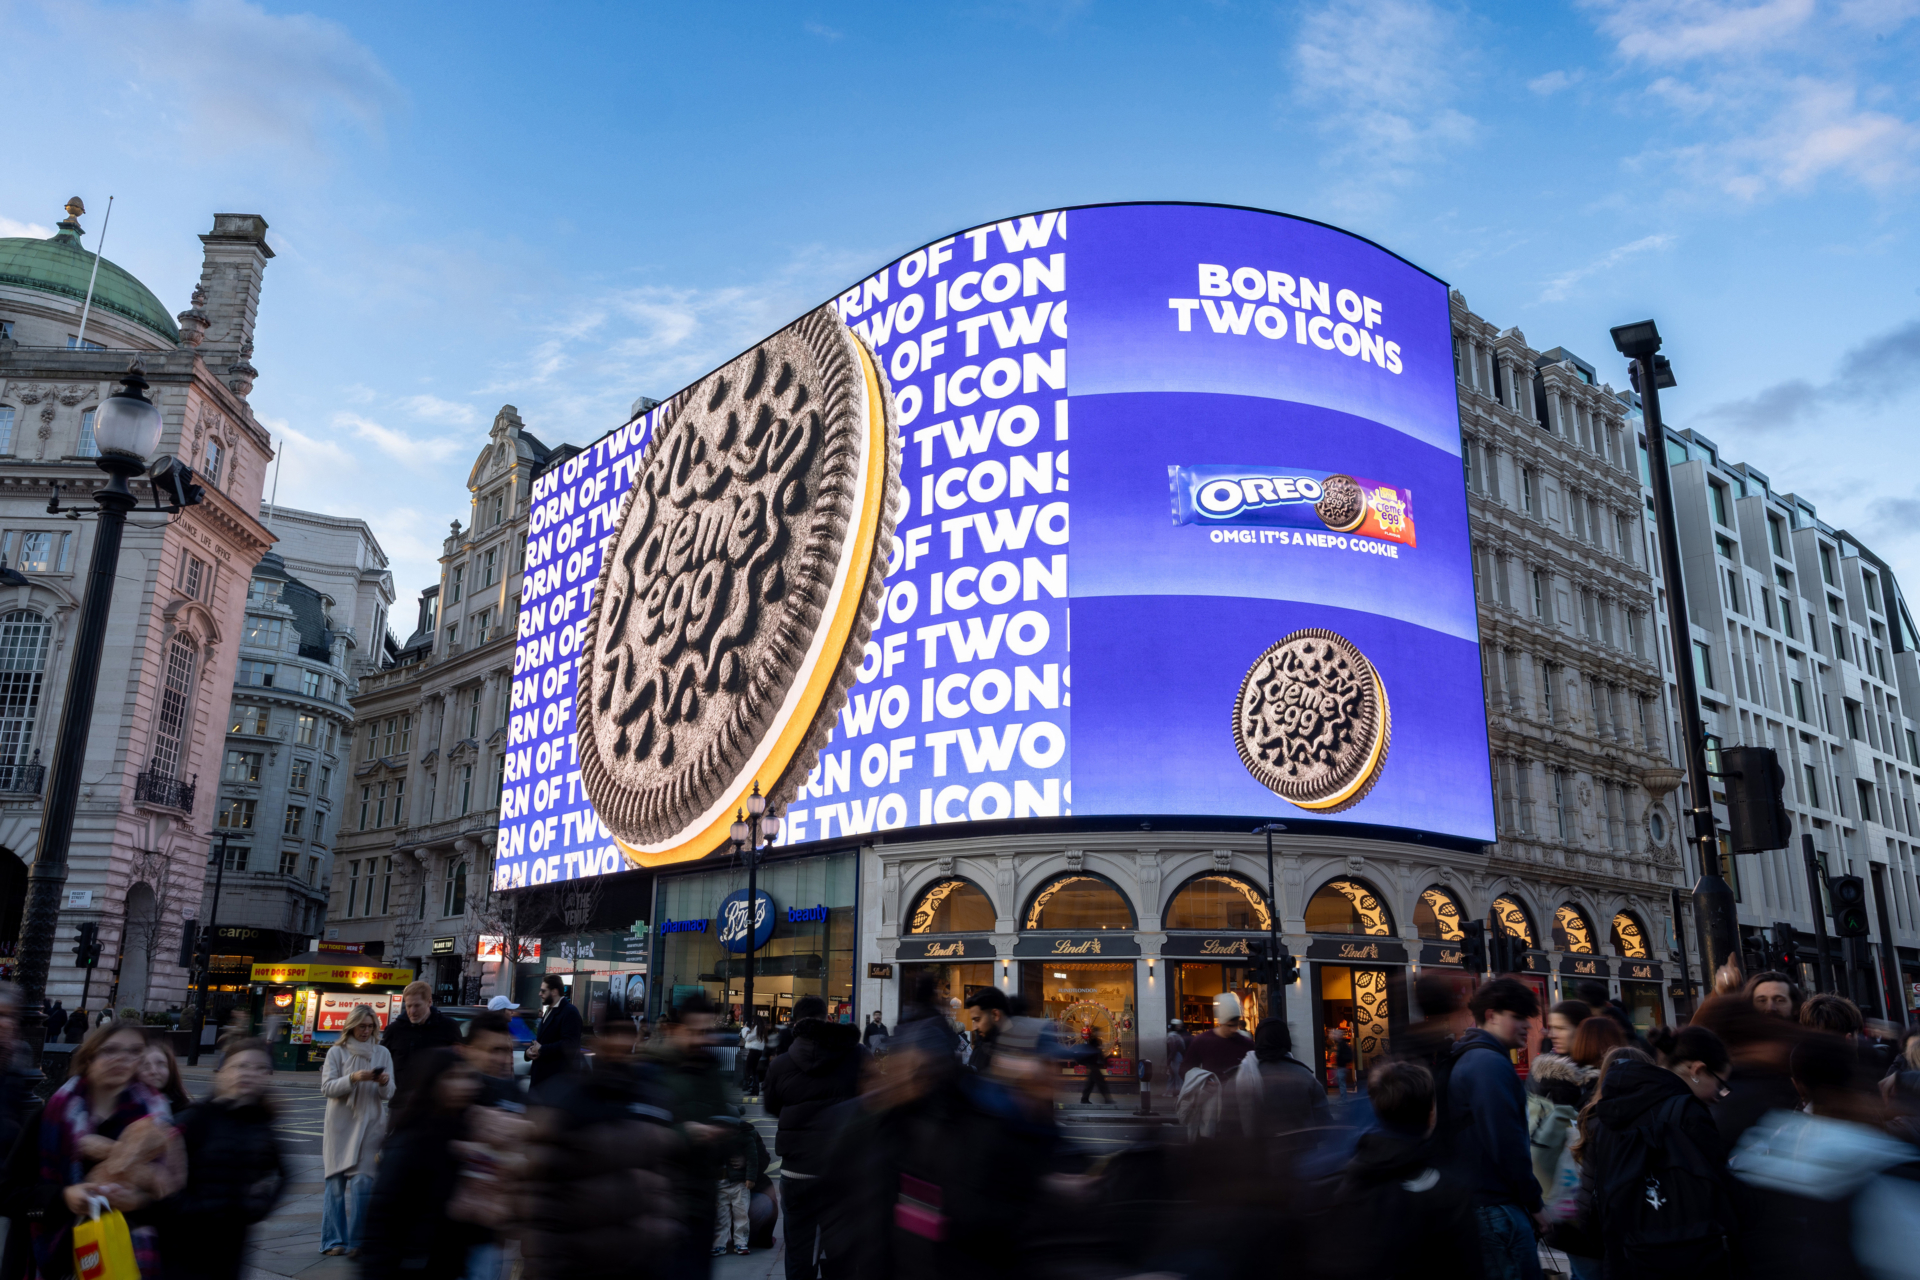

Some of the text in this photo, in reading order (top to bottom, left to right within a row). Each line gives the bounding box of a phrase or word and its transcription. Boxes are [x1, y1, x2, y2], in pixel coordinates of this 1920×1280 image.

[828, 268, 889, 322] RN
[897, 237, 956, 288] OF
[1198, 263, 1382, 329] BORN OF
[890, 325, 948, 381] OF
[1169, 298, 1403, 374] TWO ICONS
[563, 449, 590, 484] OF
[595, 416, 646, 467] TWO
[913, 404, 1040, 468] TWO
[580, 468, 608, 507] OF
[1200, 478, 1321, 512] OREO
[1376, 502, 1402, 516] creme
[1381, 512, 1399, 525] egg
[557, 515, 585, 553] OF
[941, 502, 1069, 560] TWO
[1210, 530, 1398, 559] OMG! IT'S A NEPO COOKIE
[566, 543, 595, 582] OF
[550, 587, 578, 625] OF
[642, 559, 726, 662] egg
[559, 613, 586, 656] OF
[857, 610, 1050, 684] OF TWO
[543, 661, 571, 698] OF
[1265, 681, 1336, 718] creme
[508, 697, 571, 746] RN OF
[1271, 703, 1319, 736] egg
[536, 737, 564, 773] OF
[860, 735, 916, 788] OF
[925, 721, 1066, 777] TWO
[534, 775, 562, 811] OF
[529, 816, 558, 852] OF
[815, 793, 907, 839] TWO
[495, 845, 619, 890] RN OF TWO
[660, 918, 709, 937] pharmacy
[788, 904, 829, 923] beauty
[218, 928, 259, 940] carpo
[925, 942, 955, 957] Lindt
[1052, 938, 1092, 954] Lindt
[1200, 939, 1240, 954] Lindt
[1339, 944, 1370, 958] Lindt
[254, 968, 269, 976] HOT
[287, 968, 306, 977] SPOT
[331, 970, 350, 978] HOT
[351, 971, 370, 979] DOG
[372, 972, 394, 980] SPOT
[80, 1250, 99, 1271] LEGO
